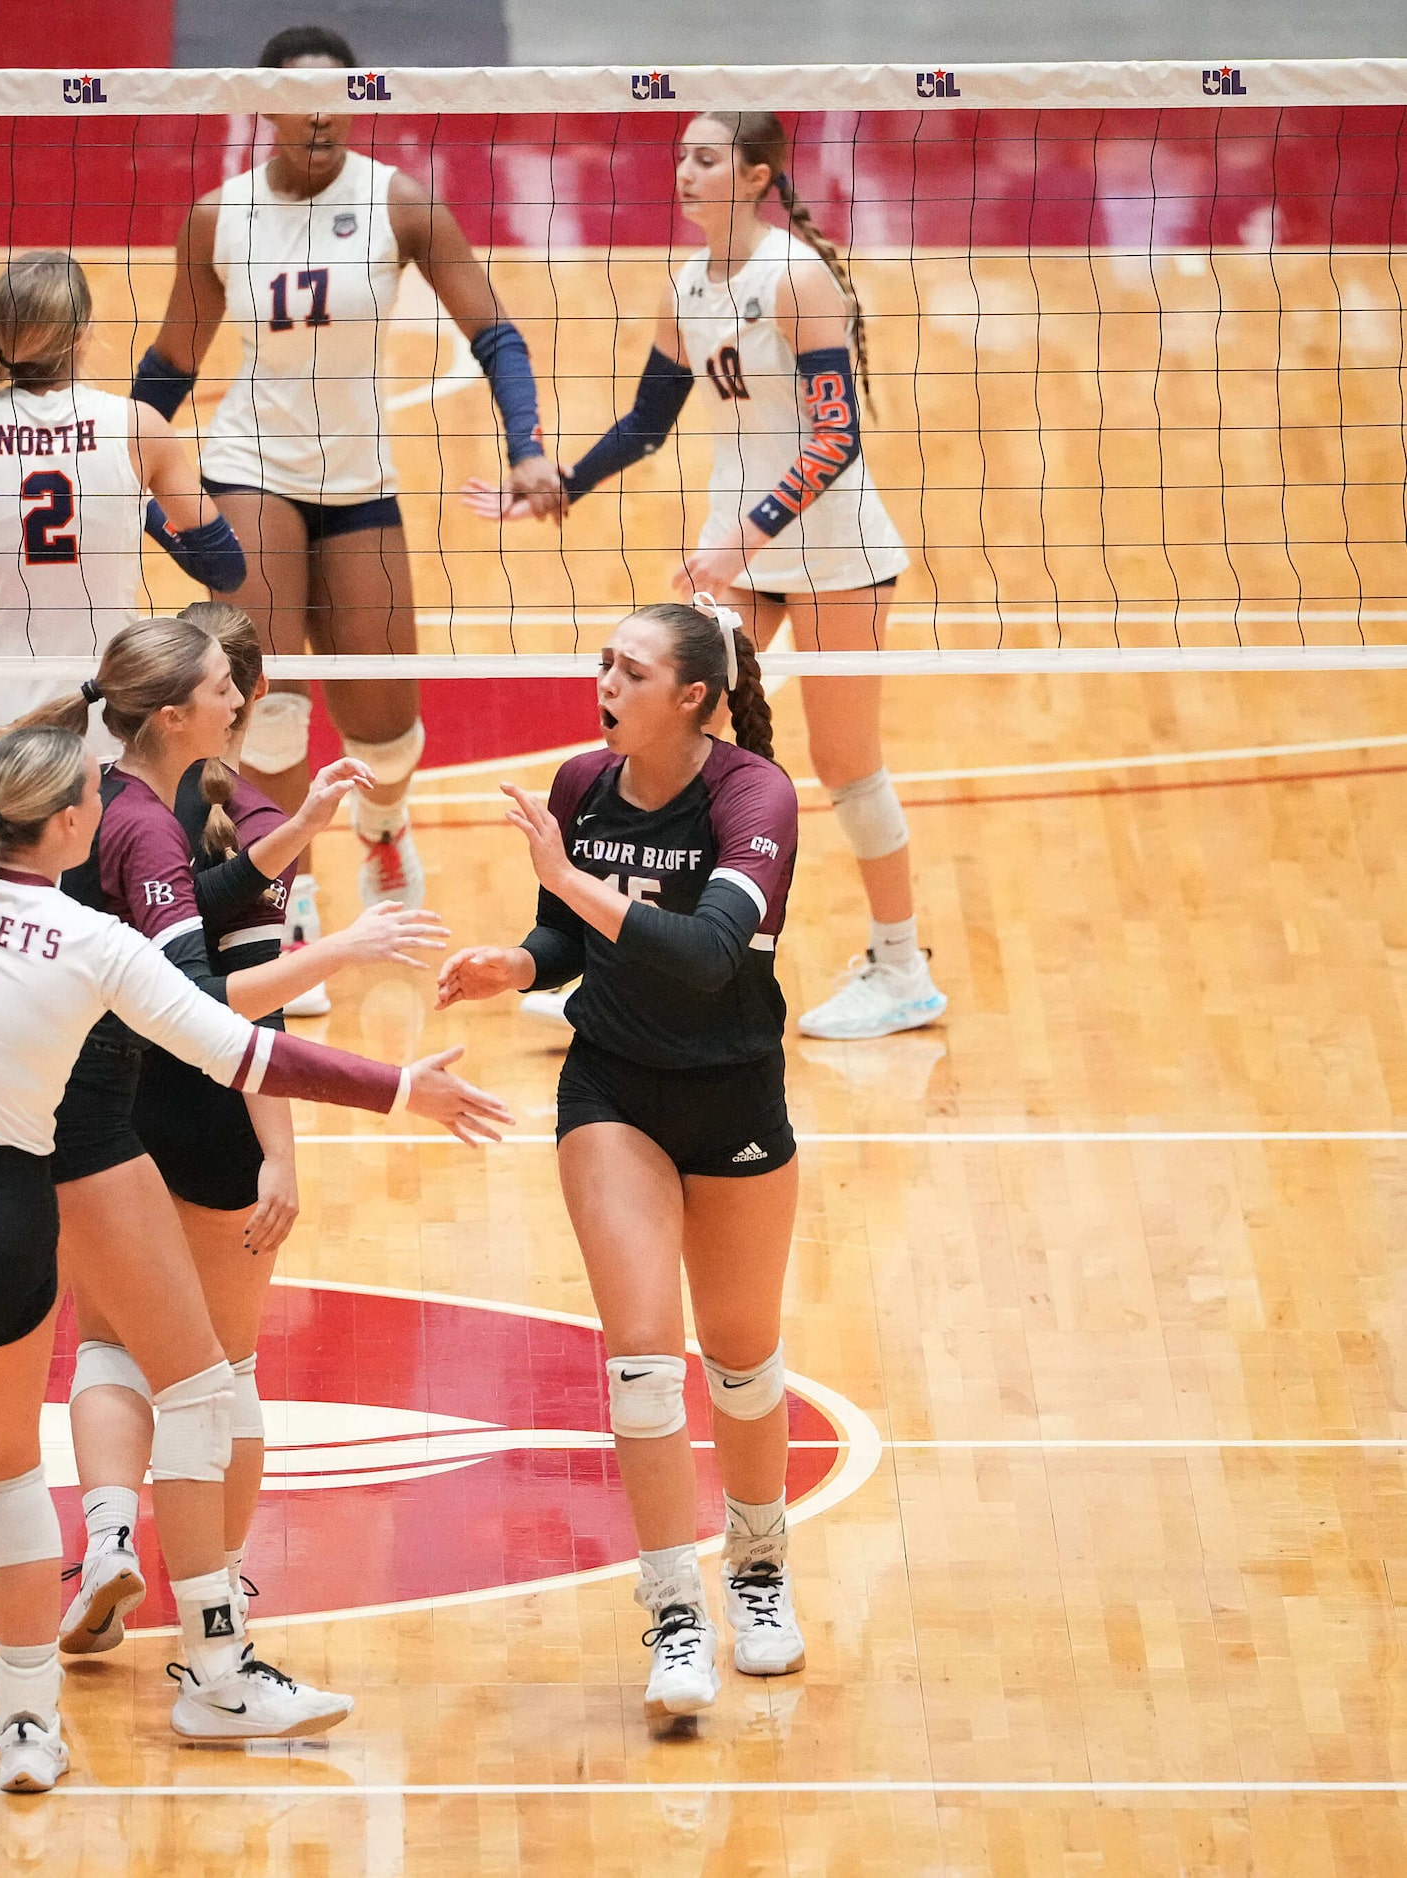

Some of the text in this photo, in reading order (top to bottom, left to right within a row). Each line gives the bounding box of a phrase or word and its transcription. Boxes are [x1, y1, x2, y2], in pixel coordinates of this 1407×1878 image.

[270, 268, 331, 332] 17
[706, 346, 750, 400] 10
[22, 470, 78, 566] 2
[573, 839, 703, 871] FLOUR BLUFF
[143, 880, 176, 906] FB
[732, 1151, 768, 1163] adidas
